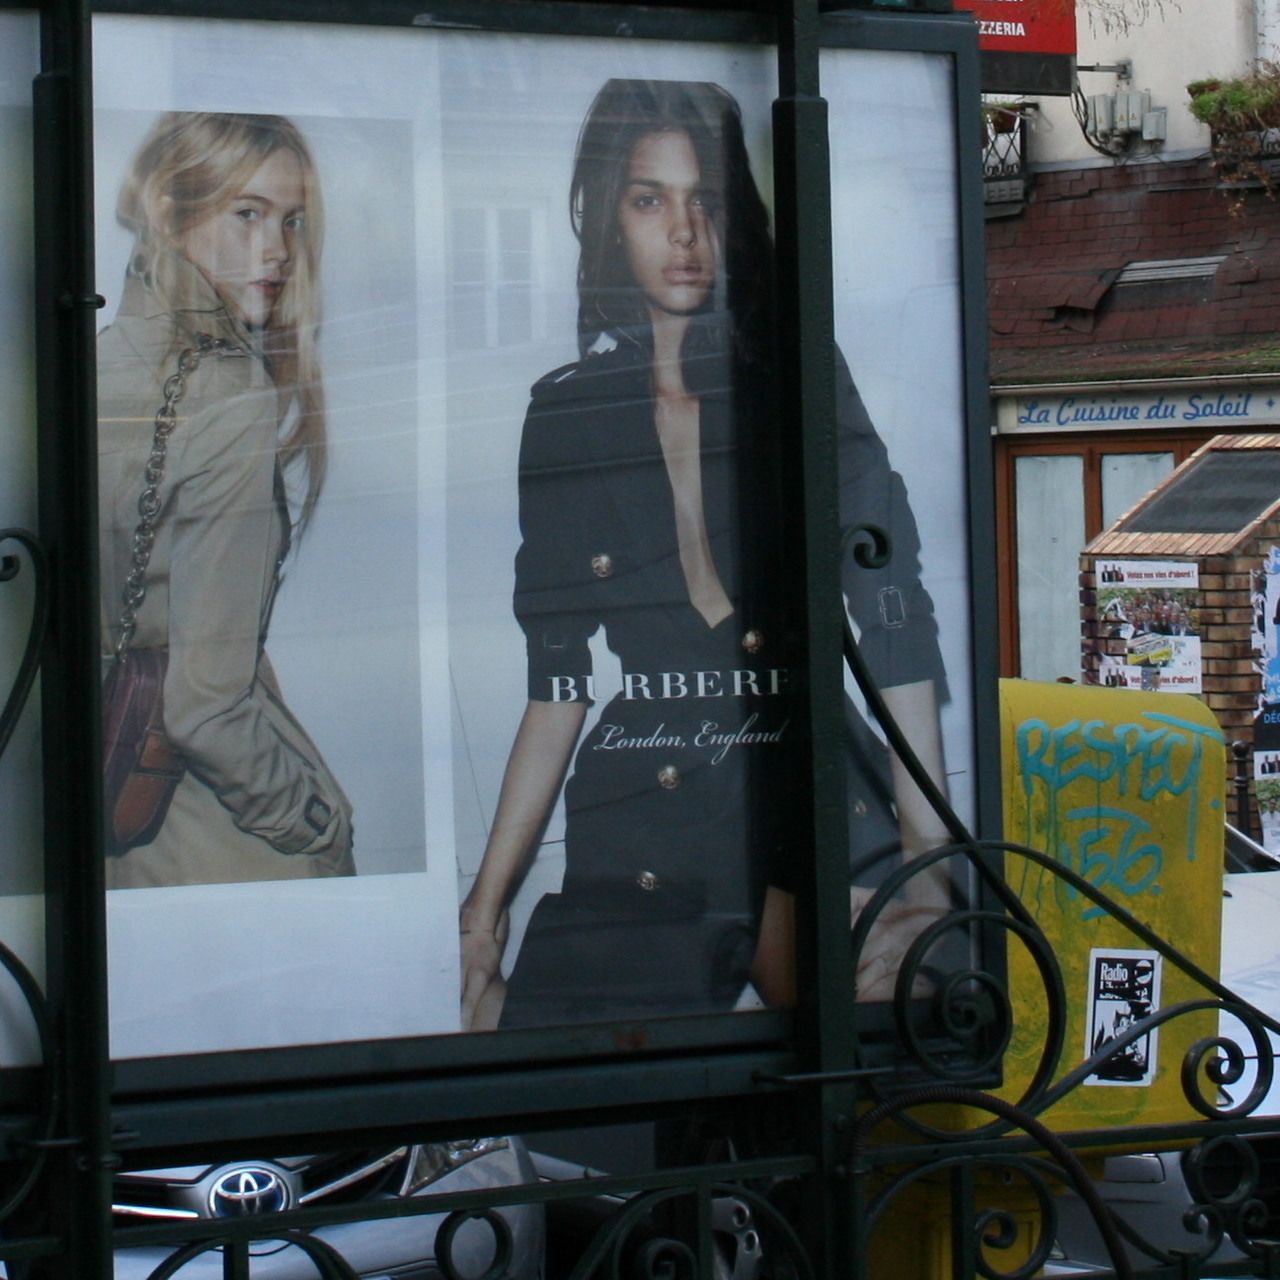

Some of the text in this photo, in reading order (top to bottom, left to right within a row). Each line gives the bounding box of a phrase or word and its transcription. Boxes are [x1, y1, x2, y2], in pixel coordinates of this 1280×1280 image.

[974, 20, 1026, 36] ZZERIA
[1019, 399, 1050, 424] La
[1056, 397, 1140, 425] Cuisine
[1143, 396, 1176, 420] du
[1183, 393, 1253, 420] Soleil
[593, 713, 788, 766] London, England
[1101, 963, 1128, 981] Radio
